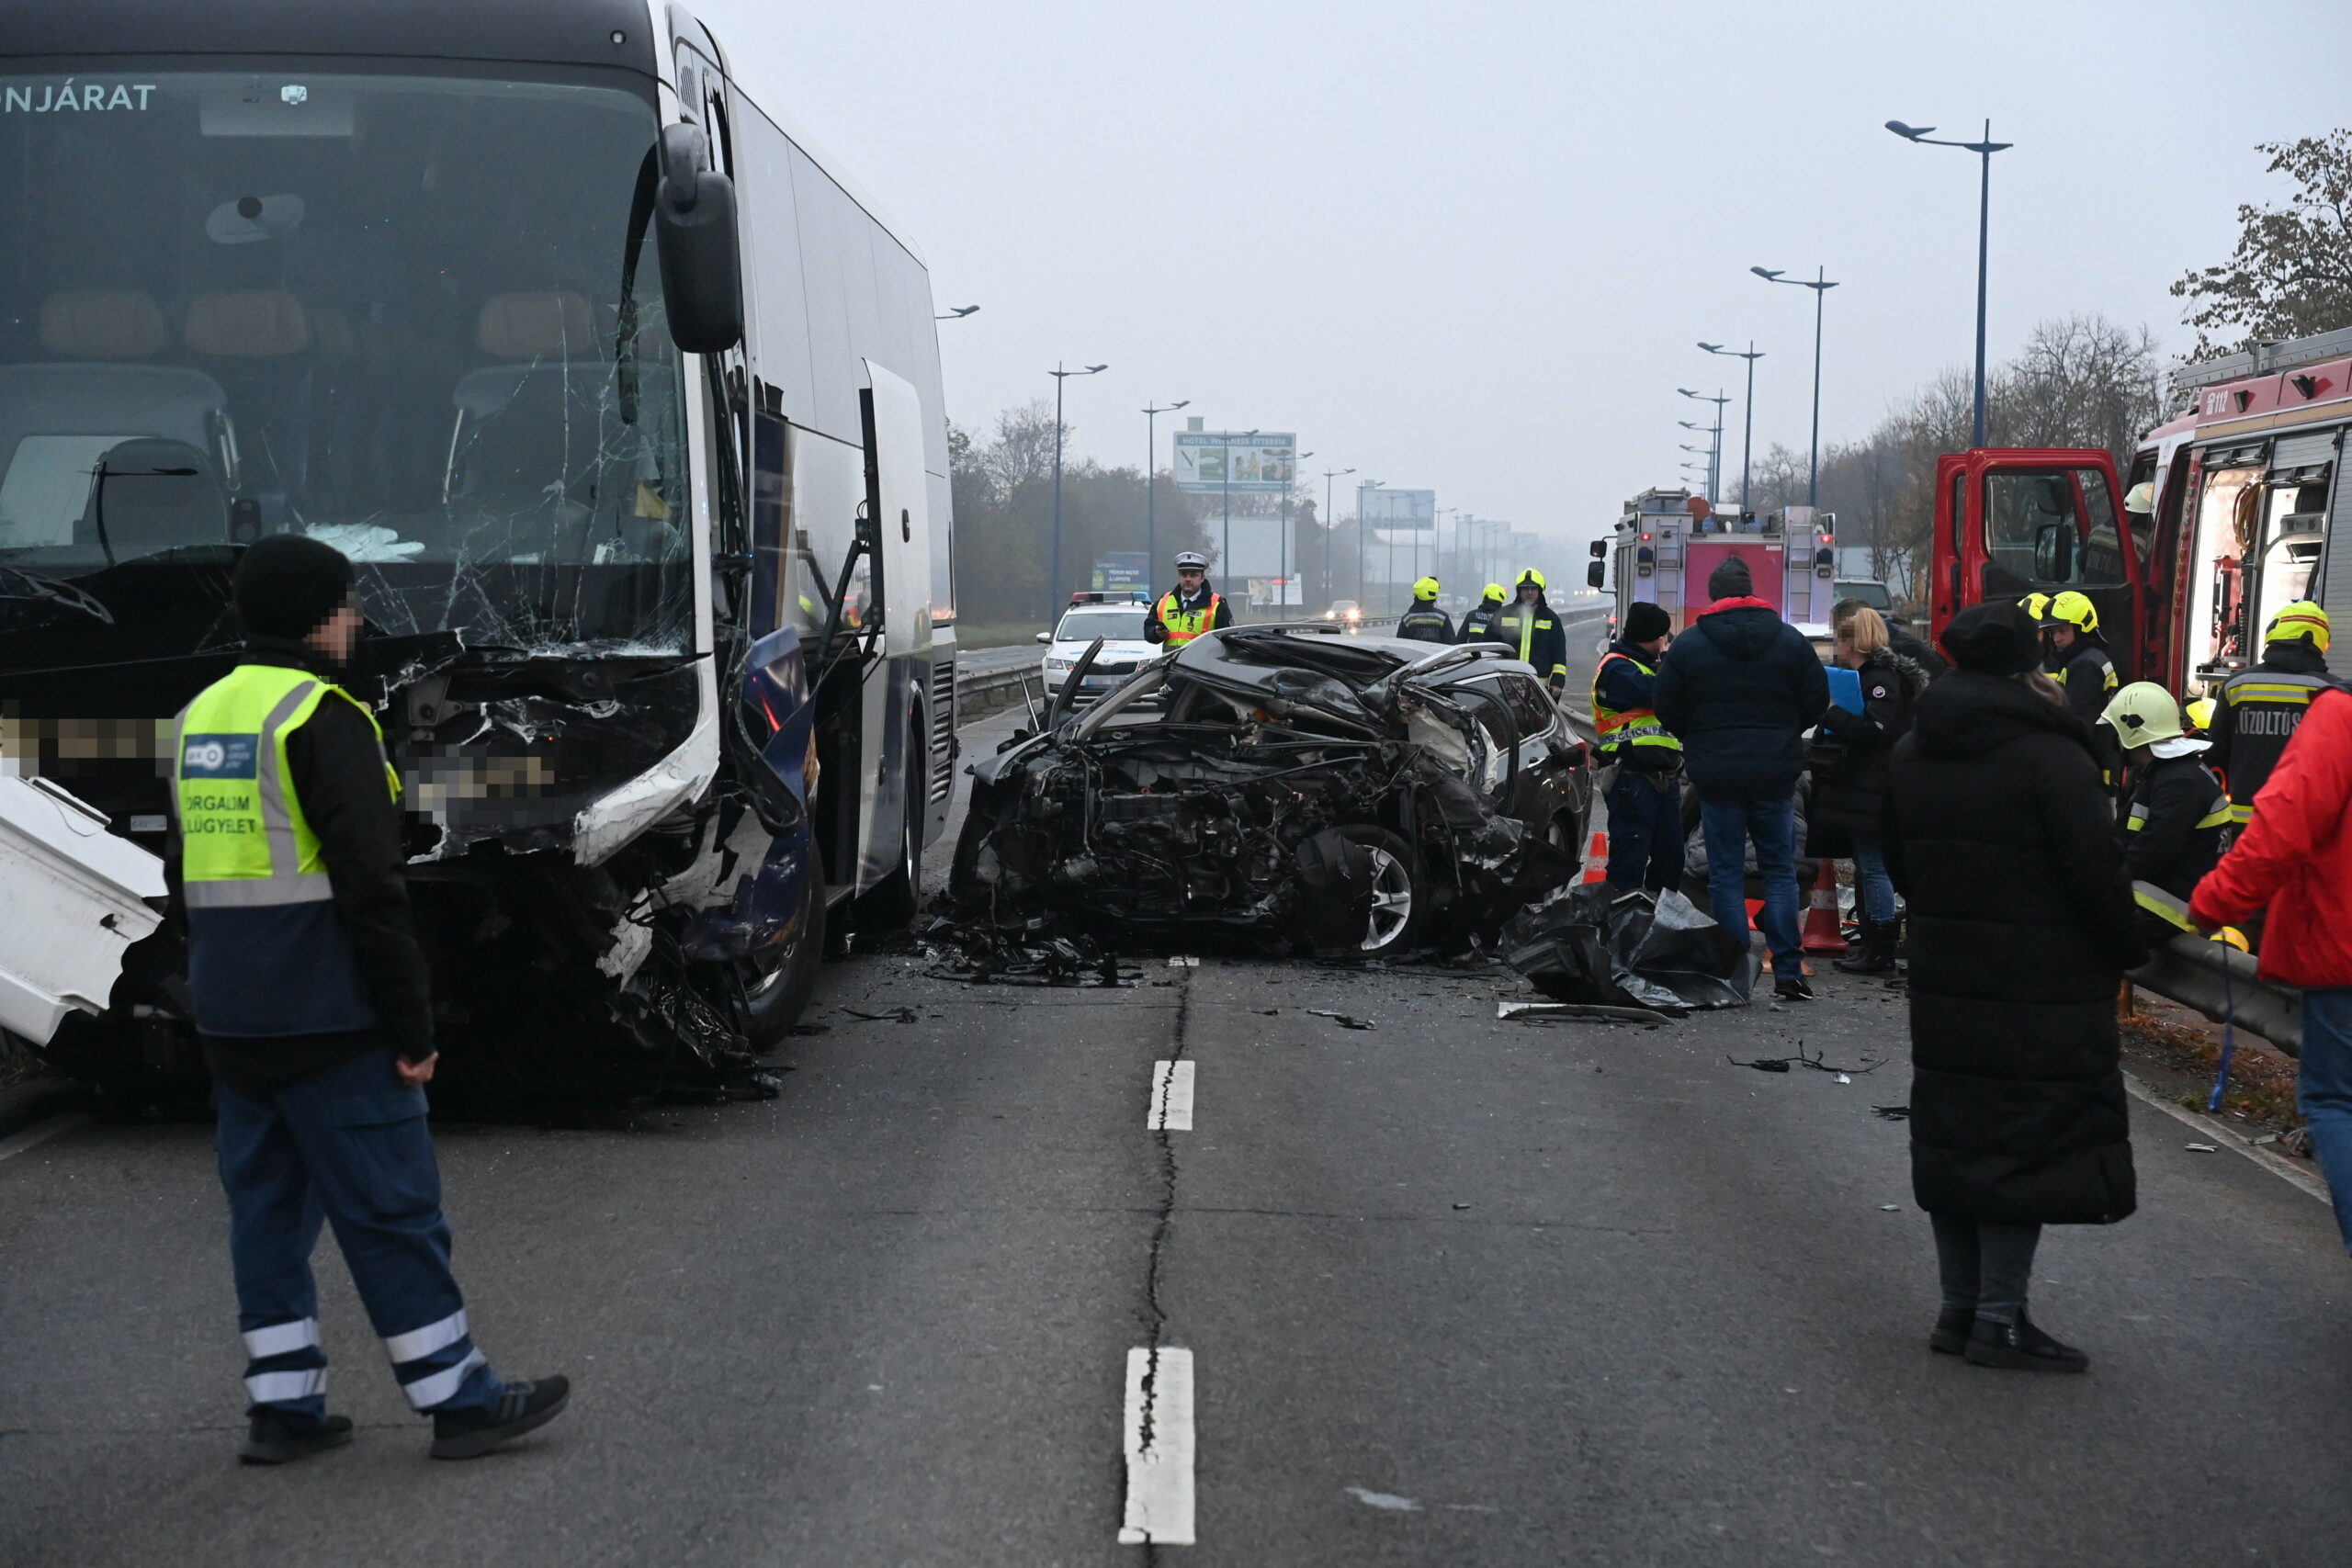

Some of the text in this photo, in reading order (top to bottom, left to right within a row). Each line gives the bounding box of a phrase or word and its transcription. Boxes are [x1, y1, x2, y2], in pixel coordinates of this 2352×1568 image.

[0, 78, 157, 112] NJÁRAT
[2215, 389, 2229, 414] 112
[1182, 436, 1207, 445] HOTEL
[2234, 706, 2301, 736] ŰZOLTÓS
